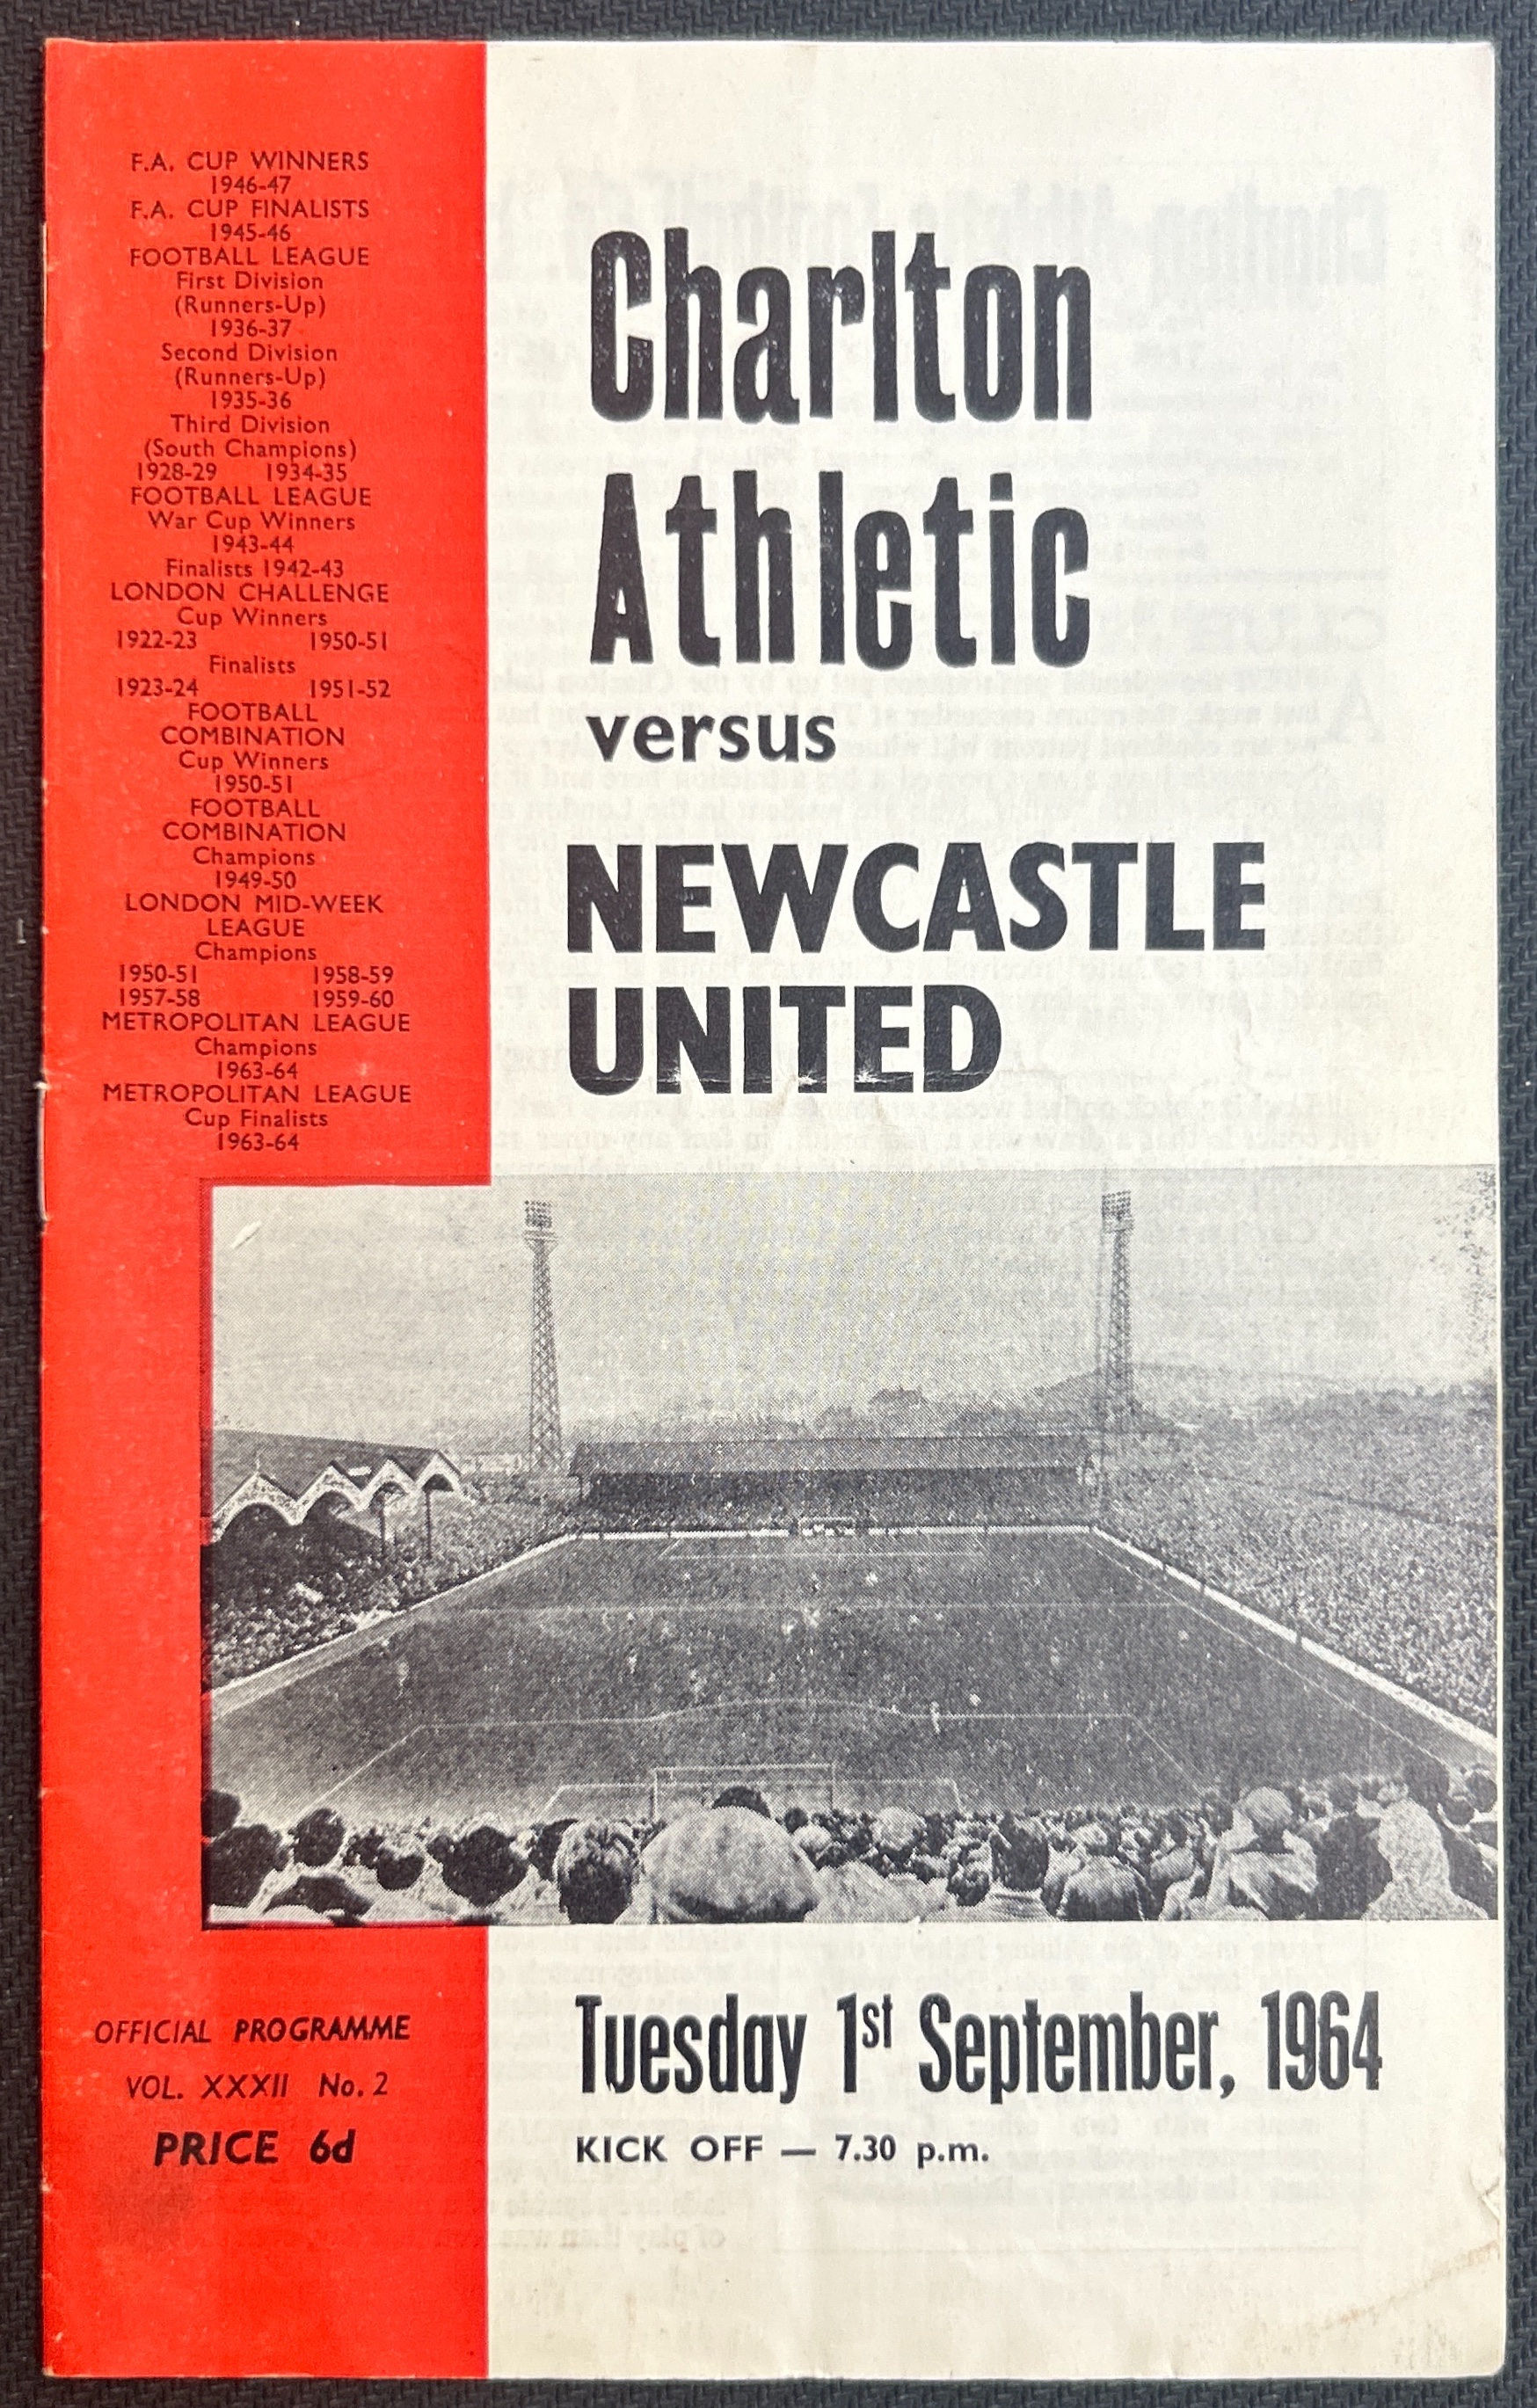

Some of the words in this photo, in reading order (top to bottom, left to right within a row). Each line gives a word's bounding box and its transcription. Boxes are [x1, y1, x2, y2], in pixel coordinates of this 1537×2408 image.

[131, 152, 174, 172] F.A.
[186, 150, 238, 172] CUP
[250, 149, 369, 171] WINNERS
[211, 175, 292, 195] 1946-47
[131, 200, 174, 220] F.A.
[186, 199, 238, 218] CUP
[251, 199, 369, 219] FINALISTS
[211, 222, 291, 243] 1945-46
[129, 246, 259, 267] FOOTBALL
[273, 246, 369, 266] LEAGUE
[176, 270, 225, 290] First
[235, 270, 324, 290] Division
[175, 295, 326, 319] (Runners-Up)
[211, 317, 292, 338] 1936-37
[590, 226, 1092, 425] Charlton
[161, 342, 237, 362] Second
[248, 342, 338, 362] Division
[174, 366, 326, 390] (Runners-Up)
[211, 389, 292, 410] 1935-36
[170, 413, 230, 433] Third
[241, 414, 330, 434] Division
[143, 437, 215, 462] (South
[224, 438, 357, 462] Champions)
[137, 462, 217, 482] 1928-29
[266, 461, 347, 483] 1934-35
[130, 485, 260, 506] FOOTBALL
[273, 486, 371, 507] LEAGUE
[147, 510, 197, 530] War
[206, 509, 251, 535] Cup
[259, 511, 355, 531] Winners
[213, 534, 295, 554] 1943-44
[166, 557, 253, 578] Finalists
[264, 558, 344, 578] 1942-43
[589, 469, 1090, 671] Athletic
[111, 581, 224, 602] LONDON
[238, 582, 389, 603] CHALLENGE
[176, 606, 222, 630] Cup
[231, 607, 328, 627] Winners
[117, 629, 197, 650] 1922-23
[310, 630, 387, 651] 1950-51
[209, 654, 296, 675] Finalists
[118, 677, 200, 697] 1923-24
[310, 679, 391, 699] 1951-52
[188, 702, 318, 723] FOOTBALL
[161, 725, 345, 747] COMBINATION
[585, 714, 836, 762] versus
[178, 749, 223, 775] Cup
[232, 750, 329, 771] Winners
[215, 774, 292, 794] 1950-51
[190, 797, 321, 818] FOOTBALL
[162, 821, 346, 843] COMBINATION
[193, 846, 316, 869] Champions
[215, 869, 296, 890] 1949-50
[125, 892, 240, 913] LONDON
[255, 894, 384, 913] MID-WEEK
[566, 841, 1265, 954] NEWCASTLE
[208, 918, 305, 937] LEAGUE
[194, 941, 317, 965] Champions
[120, 964, 197, 984] 1950-51
[314, 965, 394, 985] 1958-59
[120, 987, 200, 1008] 1957-58
[313, 989, 394, 1008] 1959-60
[102, 1011, 299, 1032] METROPOLITAN
[314, 1012, 411, 1032] LEAGUE
[194, 1036, 317, 1059] Champions
[568, 984, 1002, 1096] UNITED
[217, 1060, 298, 1080] 1963-64
[103, 1082, 299, 1104] METROPOLITAN
[315, 1084, 412, 1103] LEAGUE
[184, 1107, 230, 1131] Cup
[240, 1109, 328, 1128] Finalists
[218, 1131, 300, 1152] 1963-64
[94, 2019, 212, 2045] OFFICIAL
[233, 2014, 411, 2043] PROGRAMME
[574, 1993, 808, 2105] Tuesday
[836, 1992, 893, 2093] 1st
[918, 1990, 1235, 2106] September,
[1260, 1990, 1383, 2092] 1964
[126, 2074, 184, 2100] VOL.
[200, 2073, 289, 2099] XXXII
[318, 2072, 364, 2098] No.
[372, 2071, 388, 2097] 2
[153, 2130, 279, 2168] PRICE
[309, 2128, 356, 2165] 6d
[577, 2135, 667, 2164] KICK
[690, 2135, 763, 2162] OFF
[834, 2134, 896, 2162] 7.30
[917, 2142, 989, 2170] p.m.
